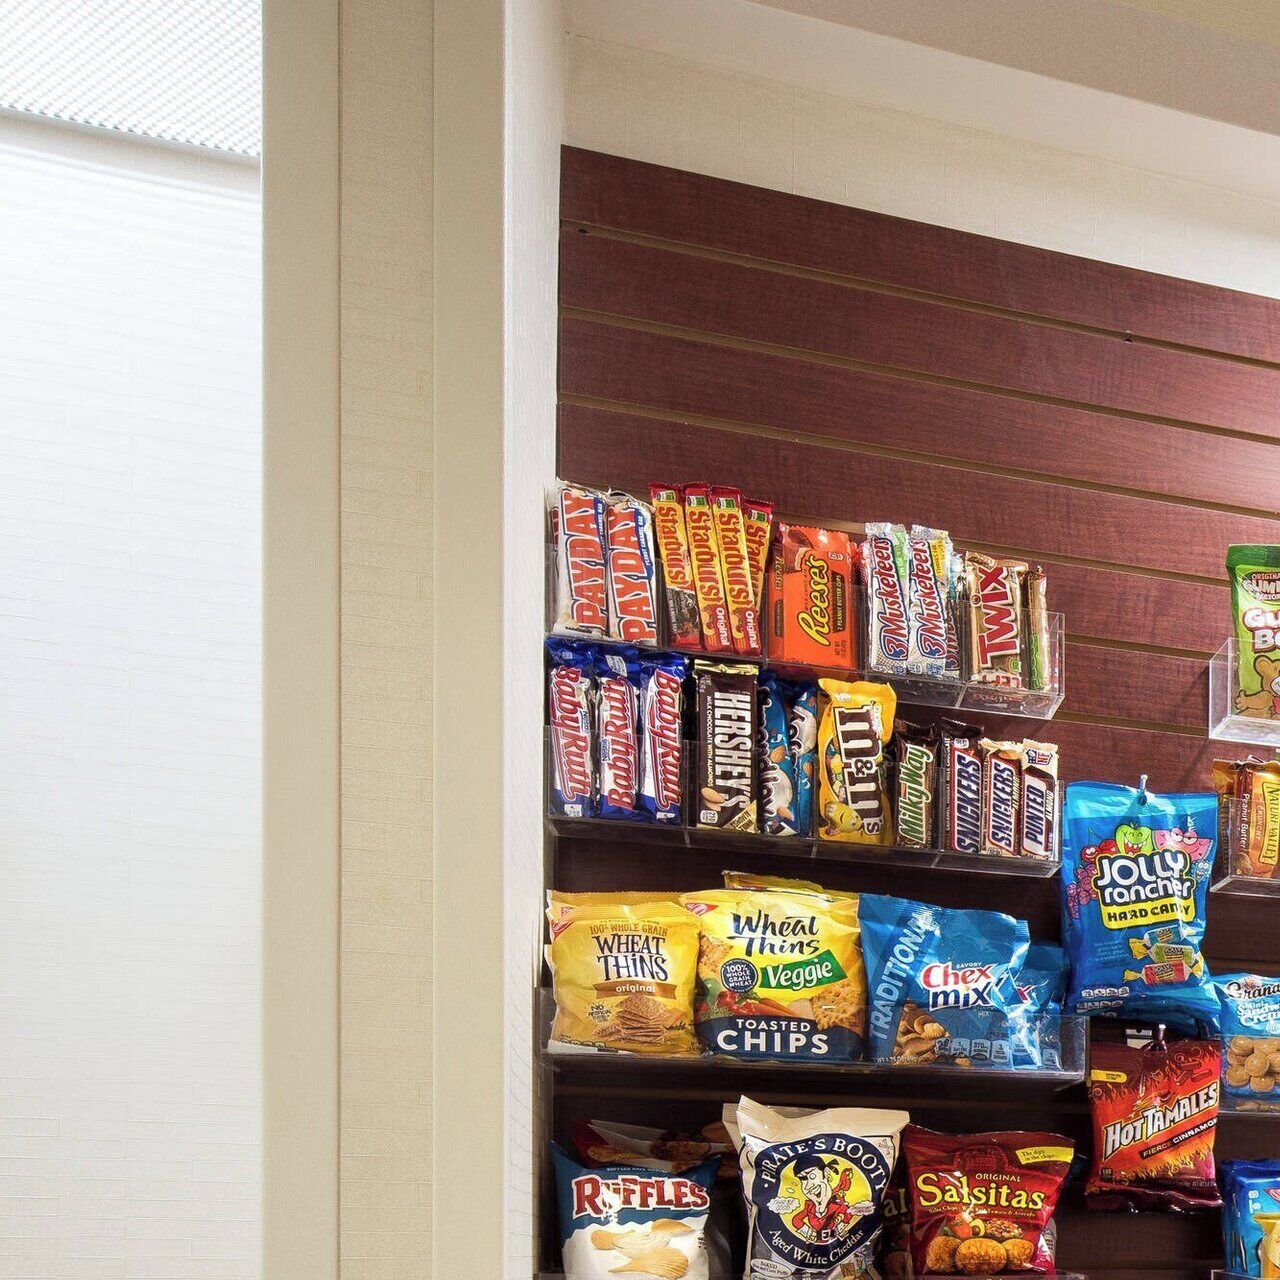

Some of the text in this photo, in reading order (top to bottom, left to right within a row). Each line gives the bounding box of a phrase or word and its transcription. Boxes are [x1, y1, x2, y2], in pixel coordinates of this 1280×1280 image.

[562, 489, 607, 631] PAYDAY
[658, 506, 691, 588] Starburst
[689, 510, 722, 608] Starburst
[719, 512, 753, 608] Starburst
[608, 507, 656, 643] PAYDAY
[716, 607, 730, 646] Original
[745, 610, 759, 649] Original
[956, 754, 981, 853] SNICKERS
[991, 762, 1015, 849] SNICKERS
[1097, 853, 1186, 888] JOLLY
[1103, 878, 1191, 905] rancher
[610, 923, 668, 936] WHOLE GRAIN
[729, 909, 820, 937] Wheat
[1107, 906, 1148, 923] HARD
[593, 934, 666, 957] WHEAT
[725, 964, 749, 973] 100%
[725, 970, 751, 978] WHOLE
[766, 957, 834, 991] Veggie
[921, 962, 997, 989] Chex
[615, 984, 657, 994] original
[929, 980, 1000, 1011] mix
[716, 1030, 829, 1055] CHIPS
[736, 1019, 811, 1032] TOASTED
[1103, 1117, 1146, 1161] HOT
[834, 1137, 887, 1192] BOOTY
[975, 1172, 1021, 1183] ORIGINAL
[916, 1173, 1045, 1210] Salsitas
[769, 1230, 864, 1264] Aged White Cheddar
